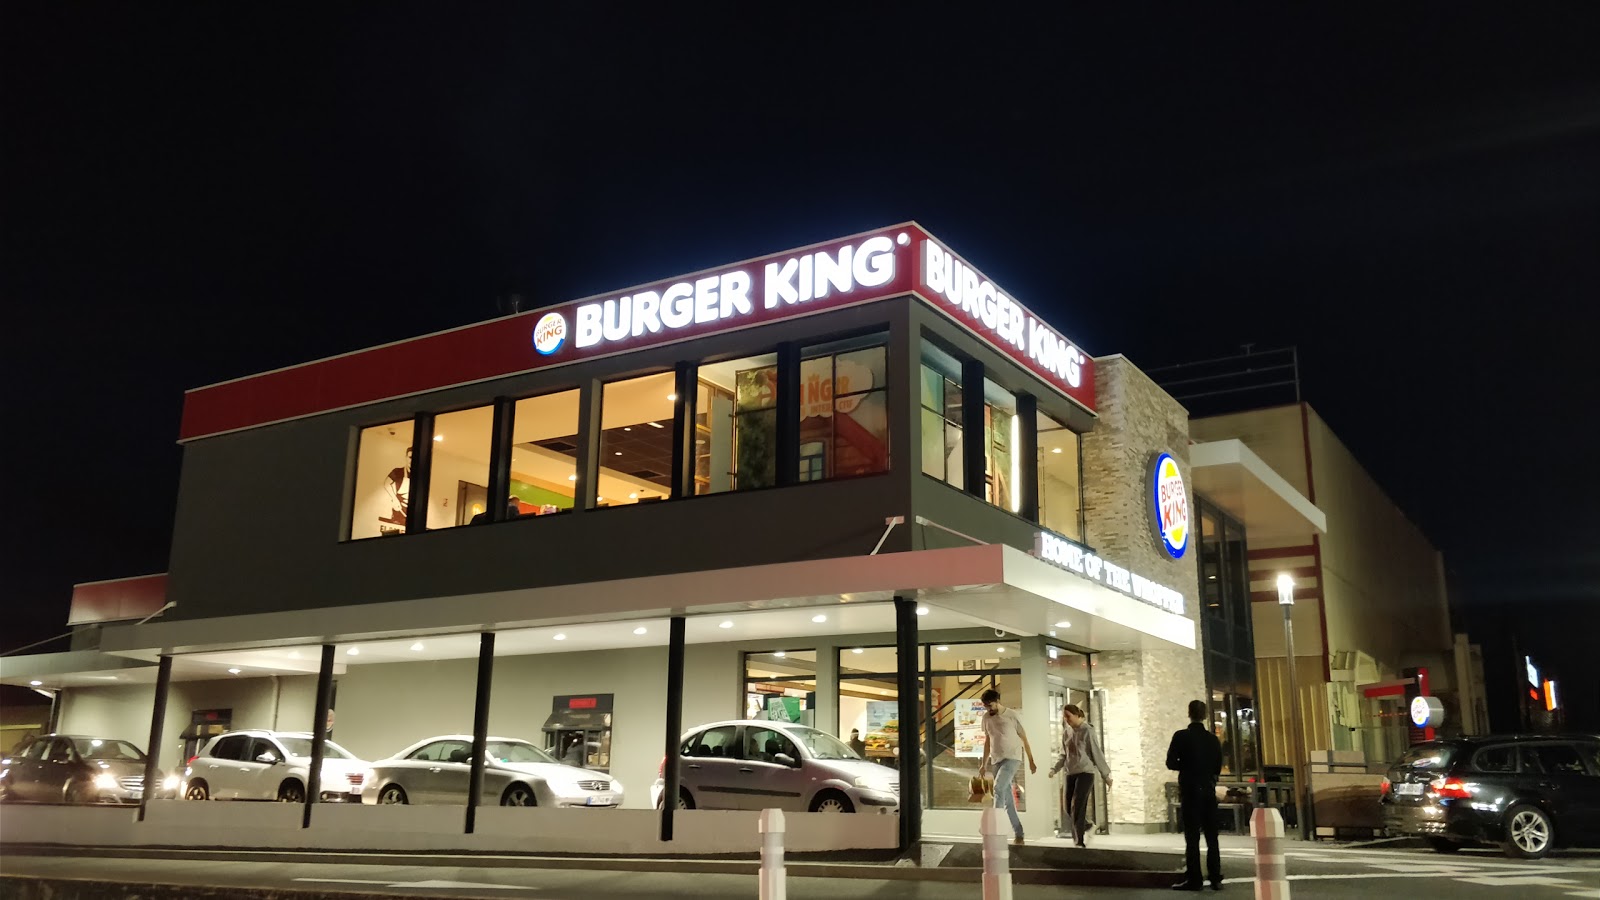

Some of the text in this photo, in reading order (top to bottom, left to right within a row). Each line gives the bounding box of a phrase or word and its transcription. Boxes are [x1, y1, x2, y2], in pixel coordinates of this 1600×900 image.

[575, 236, 896, 348] BURGER KING
[536, 318, 562, 337] BURGER
[926, 238, 1081, 388] BURGER KING
[536, 325, 563, 348] KING
[1160, 480, 1184, 503] BURGER
[1163, 497, 1187, 531] KING
[1041, 531, 1083, 573] HOME
[1084, 552, 1103, 580] OF
[1103, 560, 1131, 593] THE
